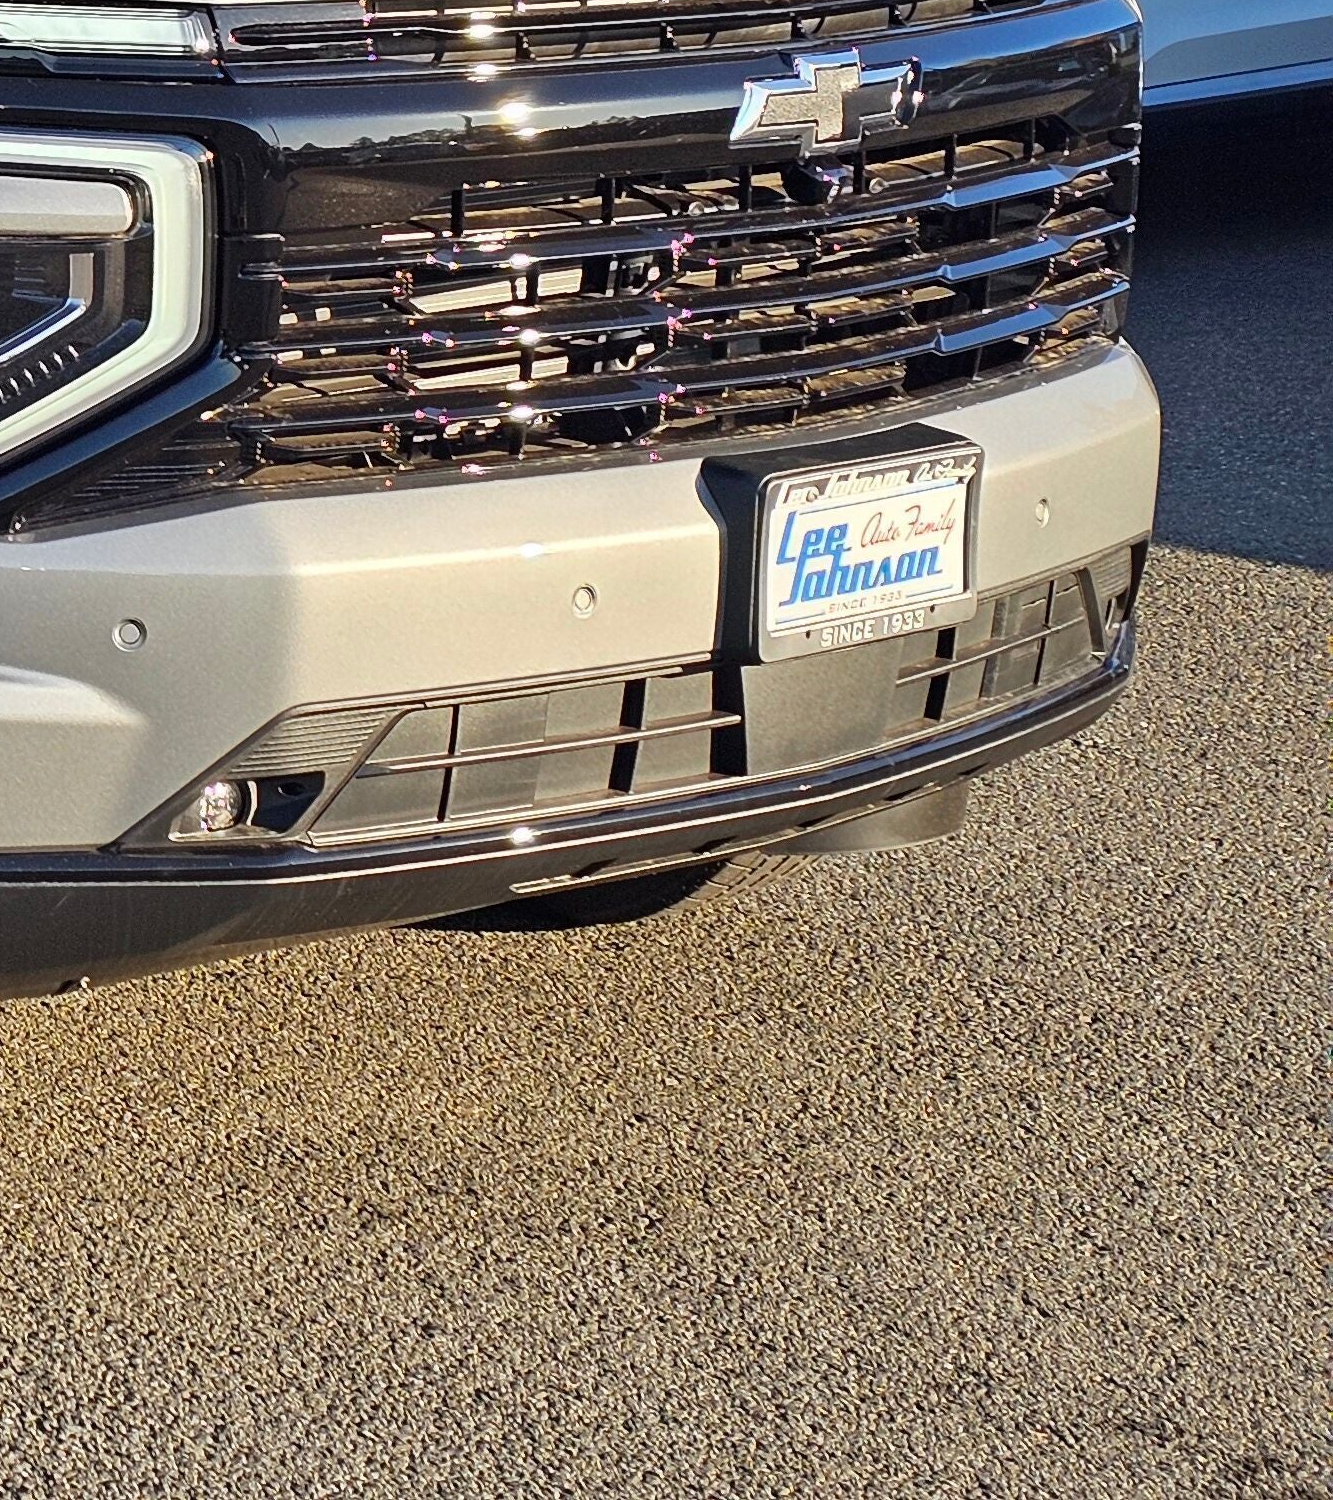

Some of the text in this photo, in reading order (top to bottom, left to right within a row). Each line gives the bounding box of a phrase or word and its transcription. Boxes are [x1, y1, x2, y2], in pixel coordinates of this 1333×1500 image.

[776, 499, 957, 565] Lee Auto Family
[778, 546, 944, 607] Johnson
[828, 590, 903, 614] SINCE 1933
[820, 608, 926, 647] SINCE 1933
